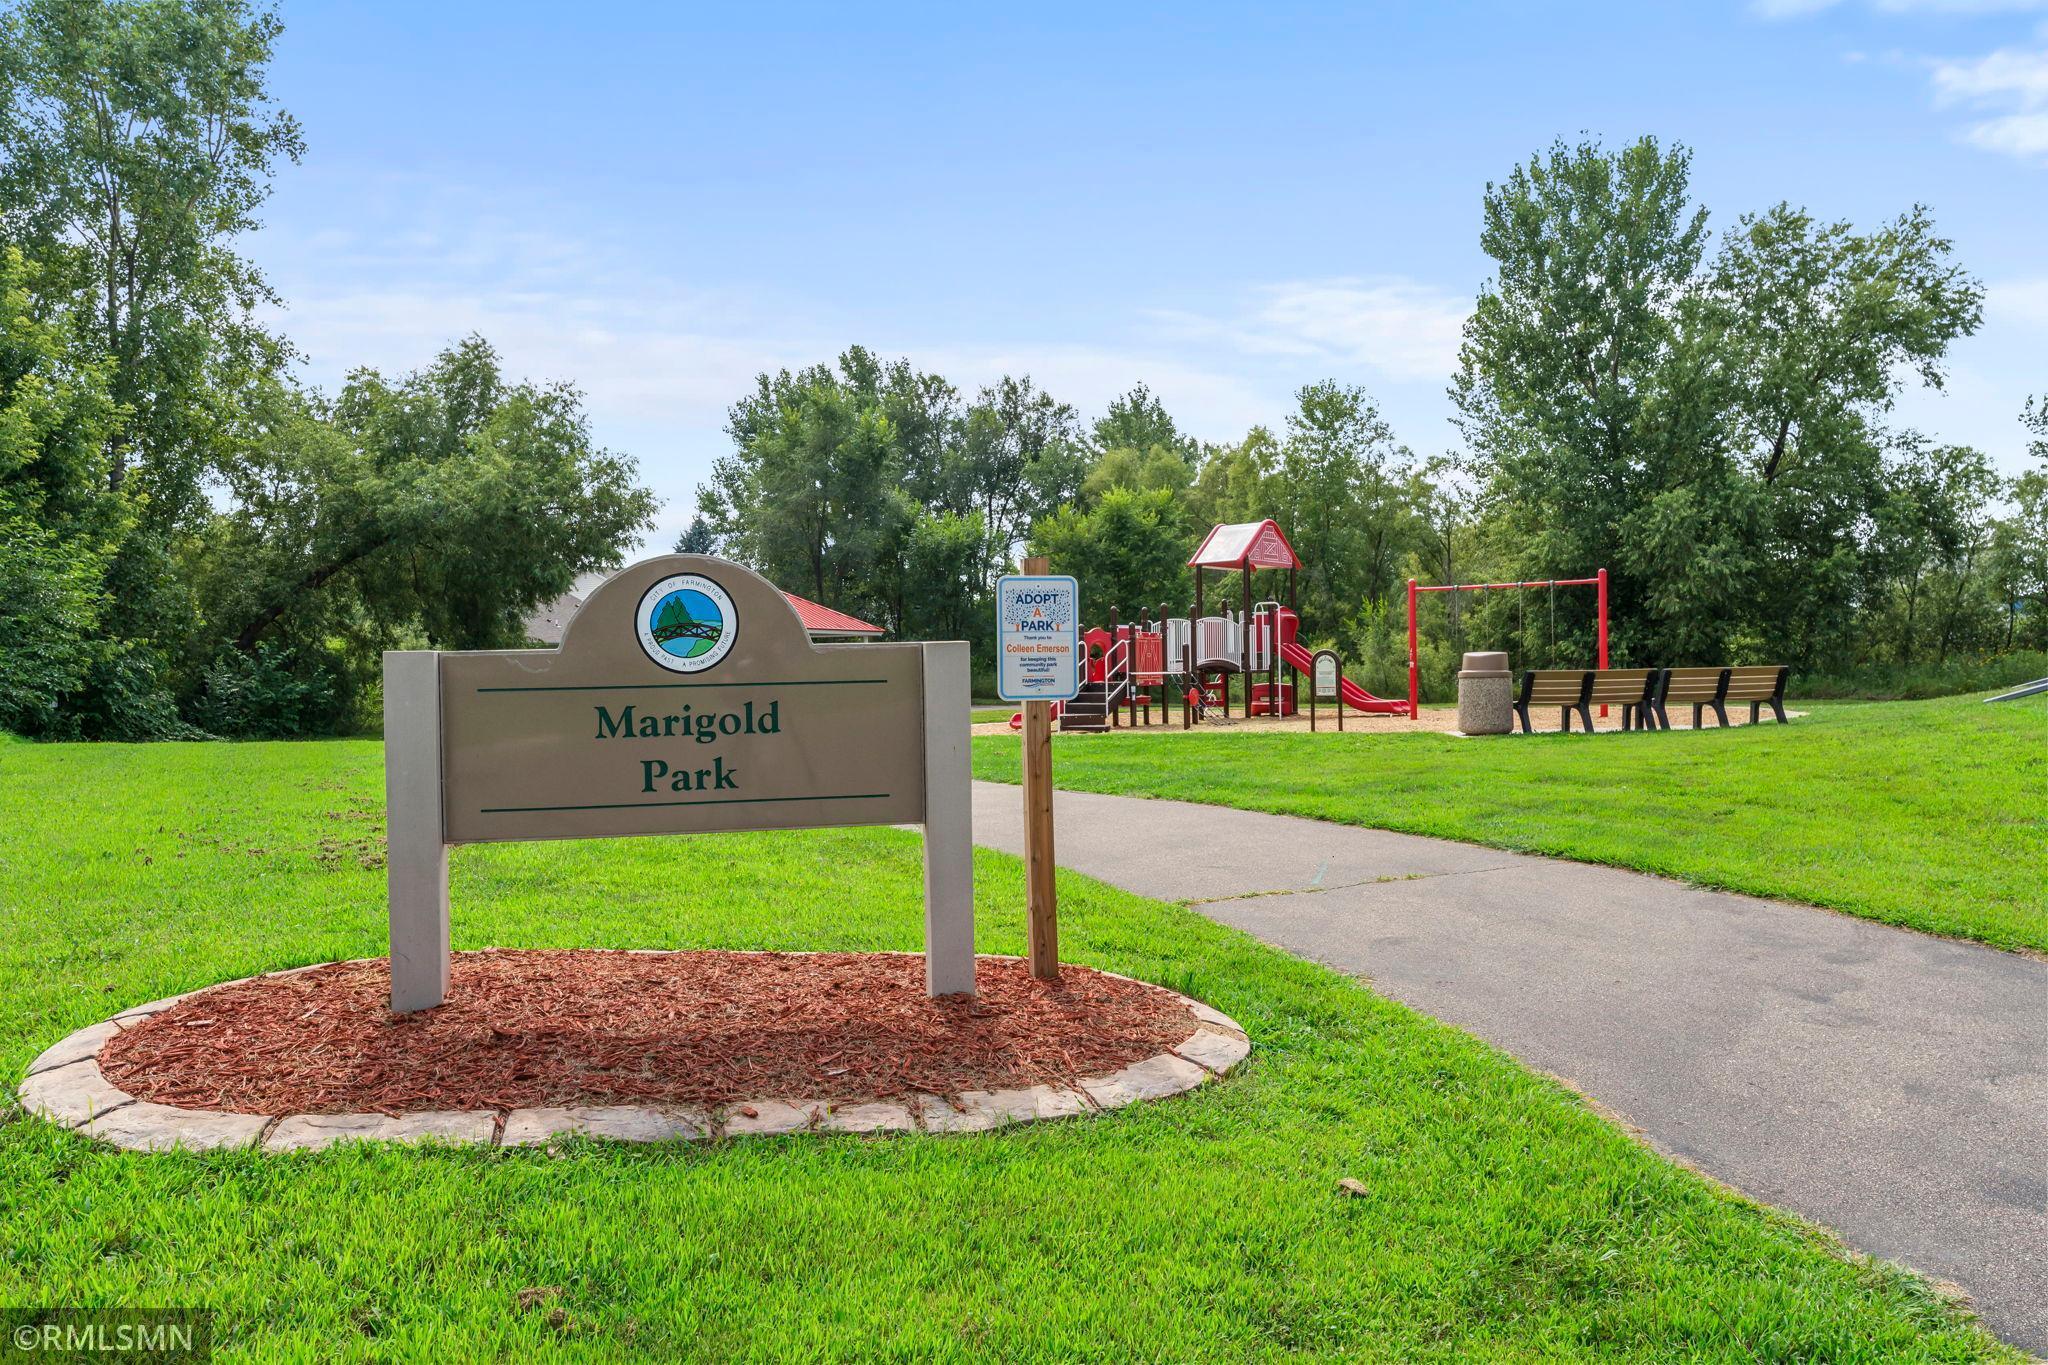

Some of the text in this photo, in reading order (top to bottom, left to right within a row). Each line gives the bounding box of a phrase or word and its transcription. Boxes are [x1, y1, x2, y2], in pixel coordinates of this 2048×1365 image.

[682, 579, 724, 601] FARMINGTON
[1016, 593, 1059, 604] ADOPT
[1033, 607, 1042, 617] A
[1021, 620, 1054, 631] PARK
[647, 638, 661, 656] PROUD
[689, 651, 719, 666] PROMISING
[1006, 644, 1070, 653] Colleen Emerson
[593, 700, 781, 744] Marigold
[639, 756, 739, 793] Park
